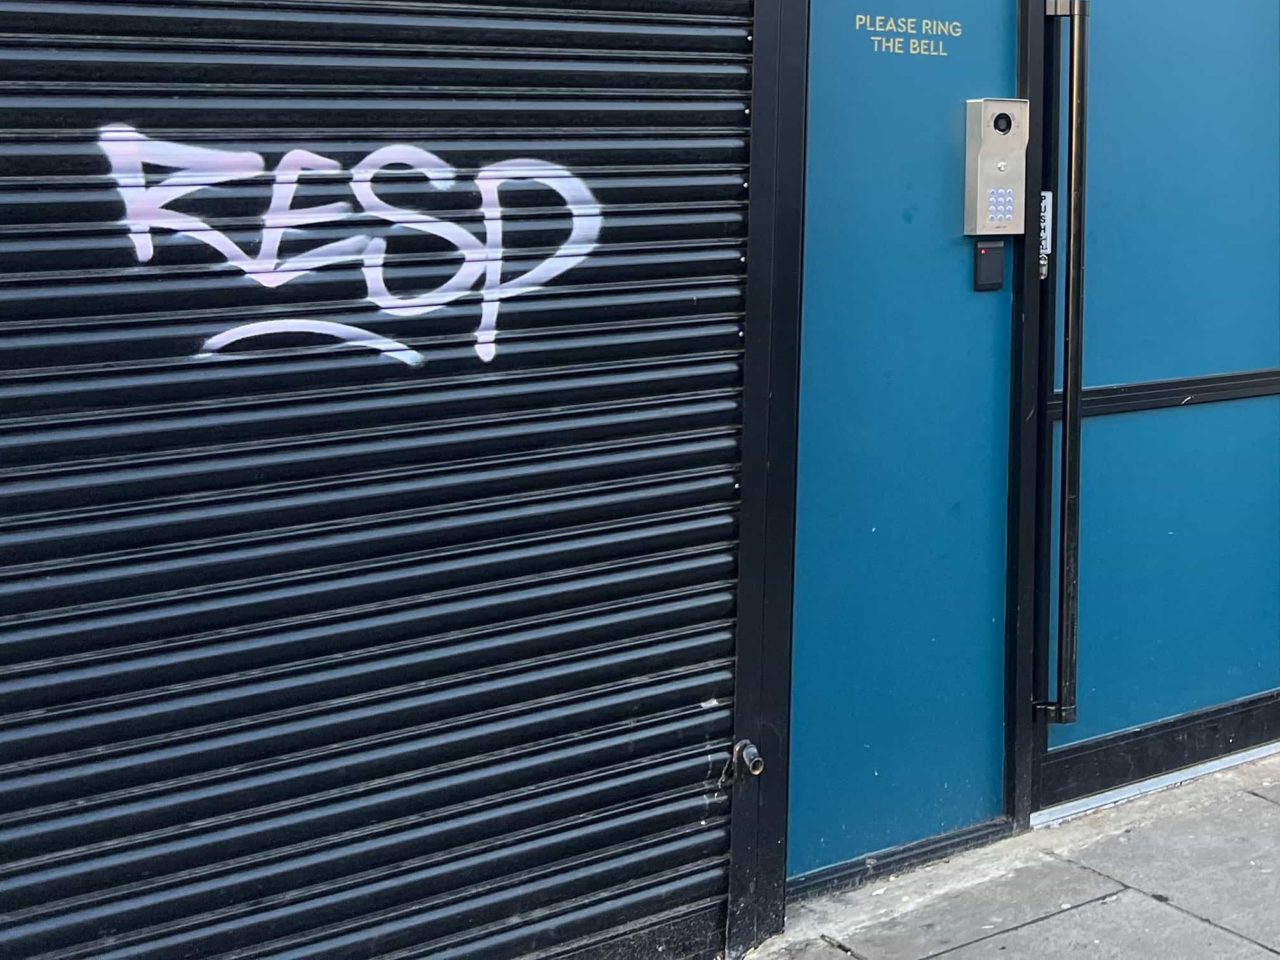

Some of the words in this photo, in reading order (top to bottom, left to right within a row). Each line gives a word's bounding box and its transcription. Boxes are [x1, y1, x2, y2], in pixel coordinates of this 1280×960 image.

[856, 14, 917, 33] PLEASE
[922, 19, 962, 37] RING
[870, 36, 904, 54] THE
[910, 39, 948, 56] BELL
